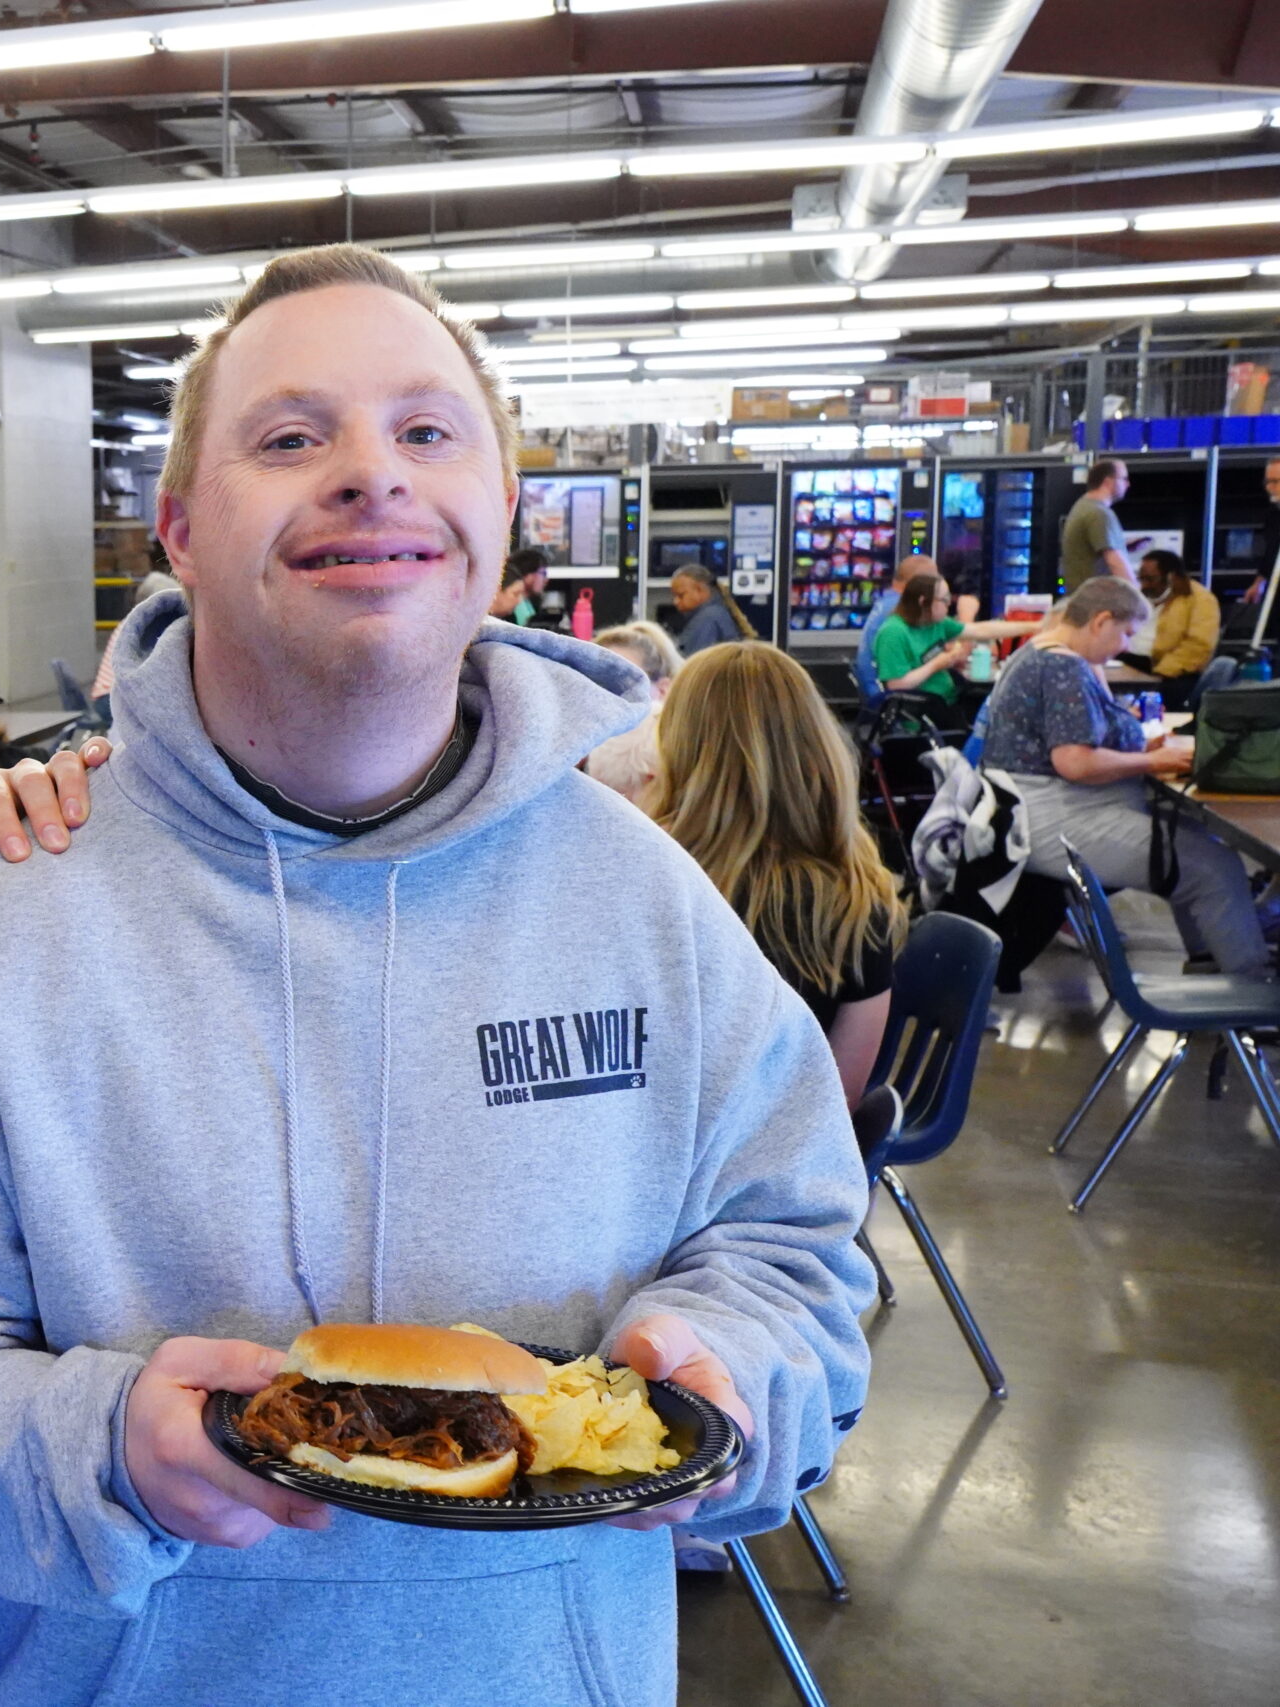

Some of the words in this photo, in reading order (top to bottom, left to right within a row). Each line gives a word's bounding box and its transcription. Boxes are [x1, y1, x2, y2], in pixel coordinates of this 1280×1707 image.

[476, 1015, 571, 1087] GREAT
[572, 1007, 649, 1075] WOLF
[485, 1087, 531, 1107] LODGE
